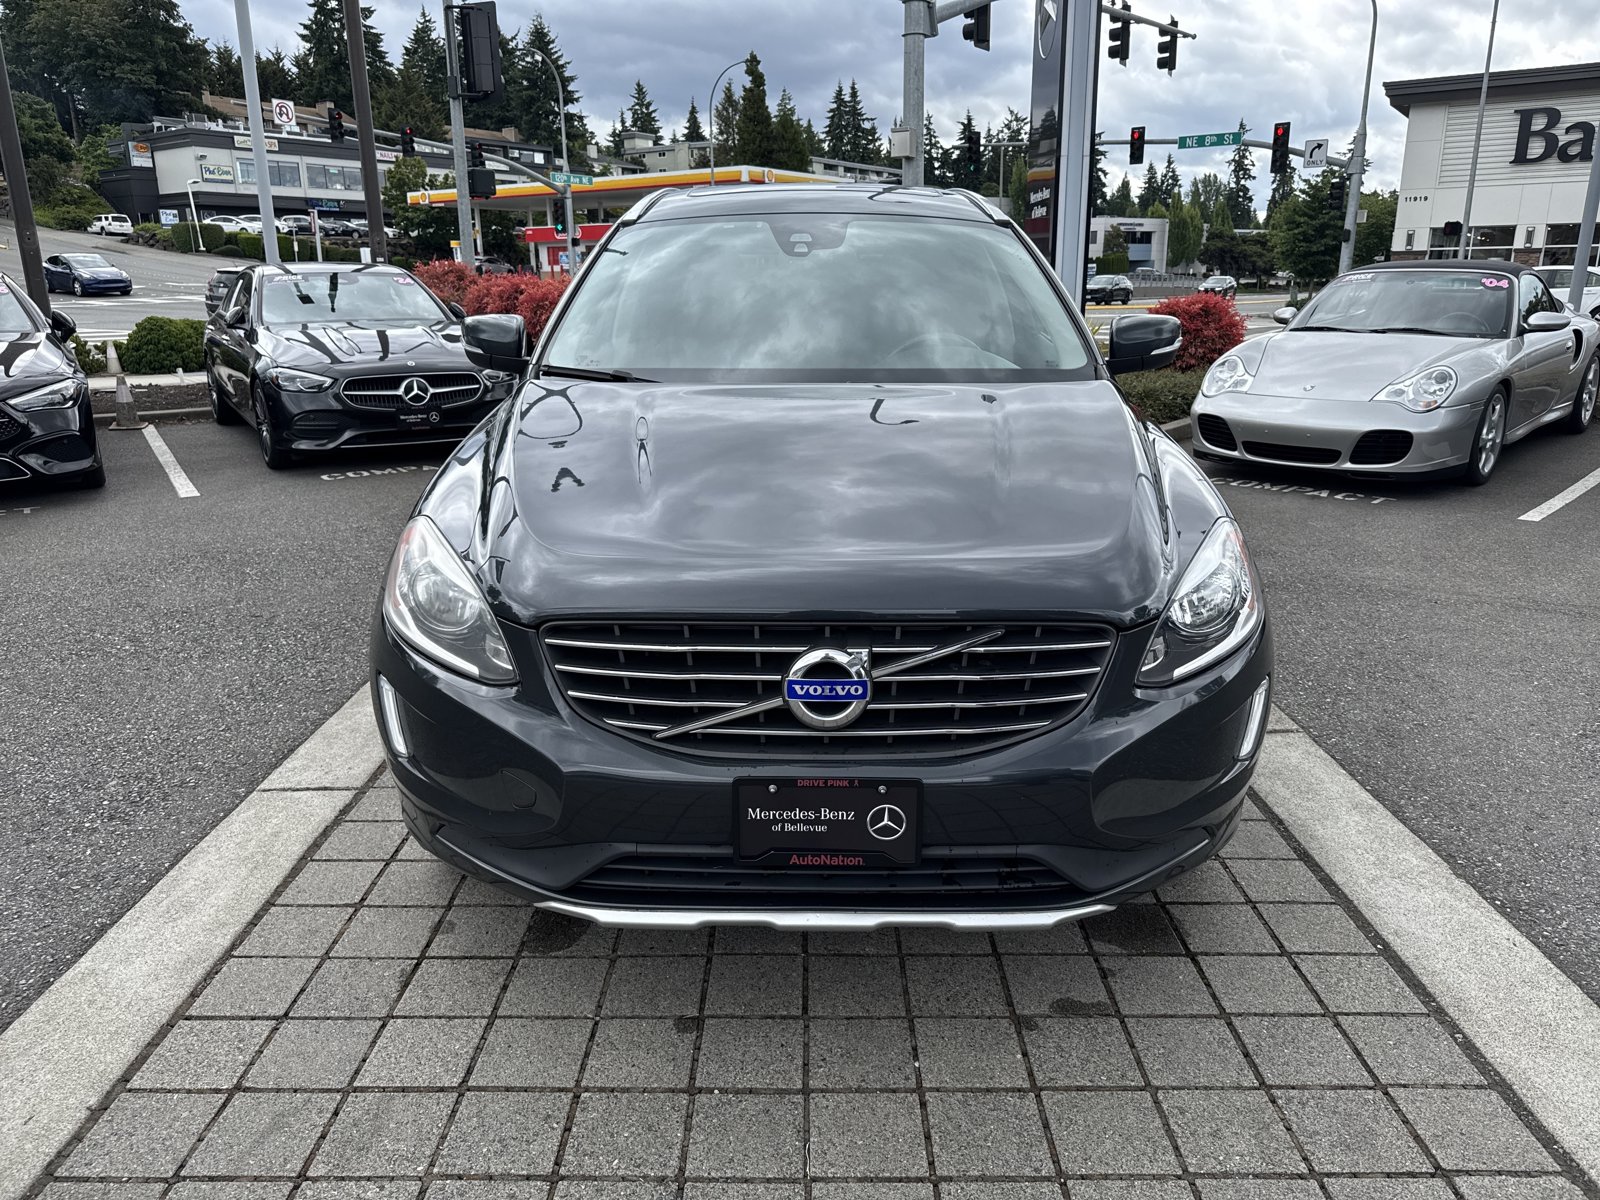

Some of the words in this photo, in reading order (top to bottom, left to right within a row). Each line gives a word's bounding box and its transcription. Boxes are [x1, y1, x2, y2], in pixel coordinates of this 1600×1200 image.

[1185, 136, 1199, 147] NE
[1204, 136, 1218, 146] 8th
[1223, 133, 1234, 145] St
[1509, 107, 1596, 164] Ba
[570, 175, 580, 184] Ave
[581, 176, 590, 185] NE
[1404, 195, 1429, 203] 11919
[1210, 477, 1398, 504] COMPACT
[791, 684, 864, 696] VOLVO
[797, 779, 825, 787] DRIVE
[827, 779, 850, 787] PINK
[747, 807, 855, 820] Mercedes-Benz
[771, 822, 782, 832] of
[784, 822, 828, 832] Bellevue
[789, 854, 864, 866] AutoNation
